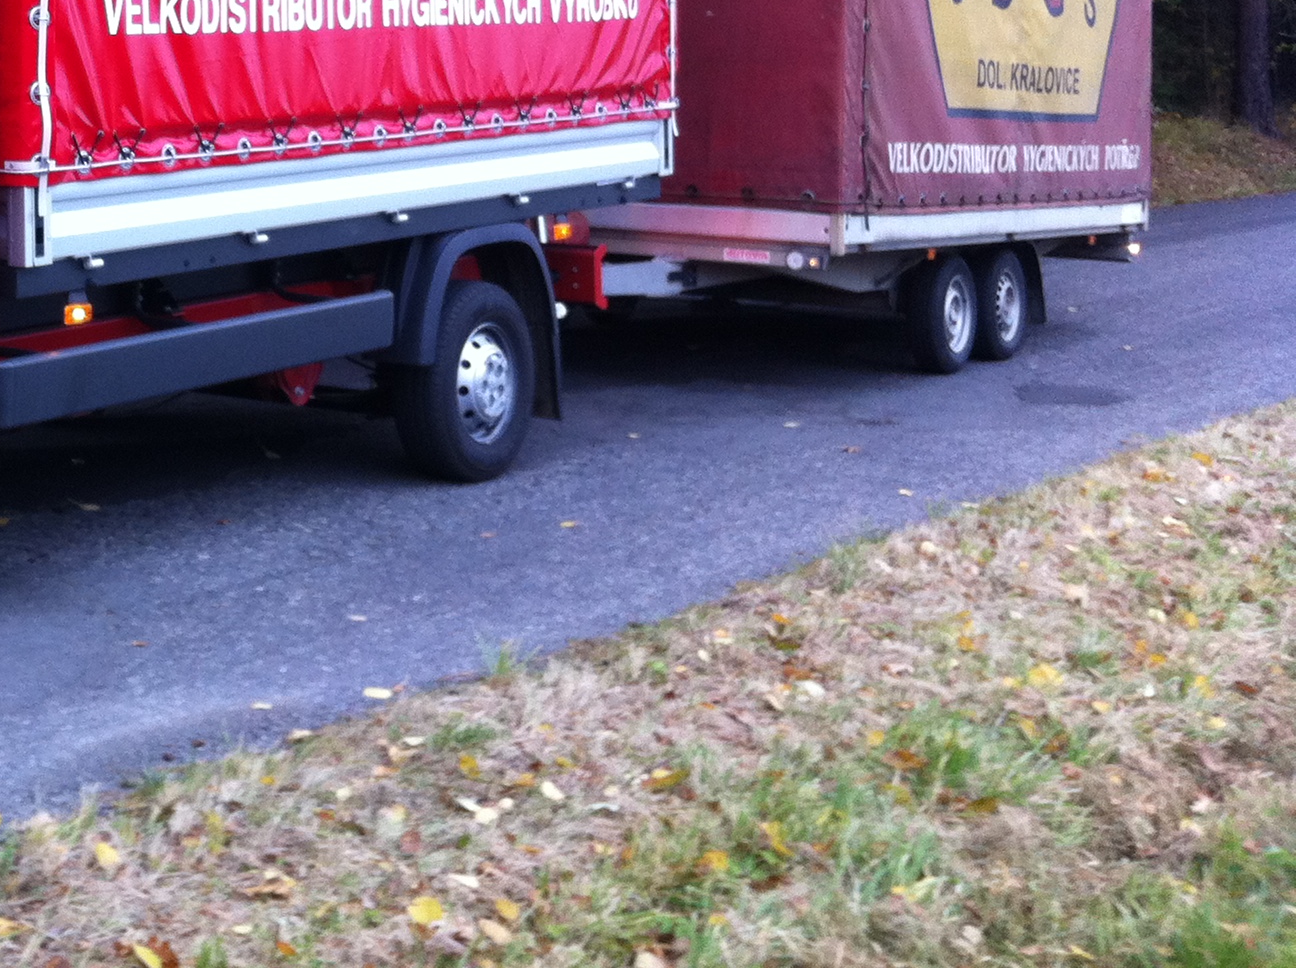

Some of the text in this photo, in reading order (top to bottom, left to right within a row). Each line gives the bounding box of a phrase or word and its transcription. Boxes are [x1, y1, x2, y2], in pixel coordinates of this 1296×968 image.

[976, 59, 1081, 94] DOL. KRALOVICE
[887, 142, 1018, 174] VELKODISTRIBUTOR
